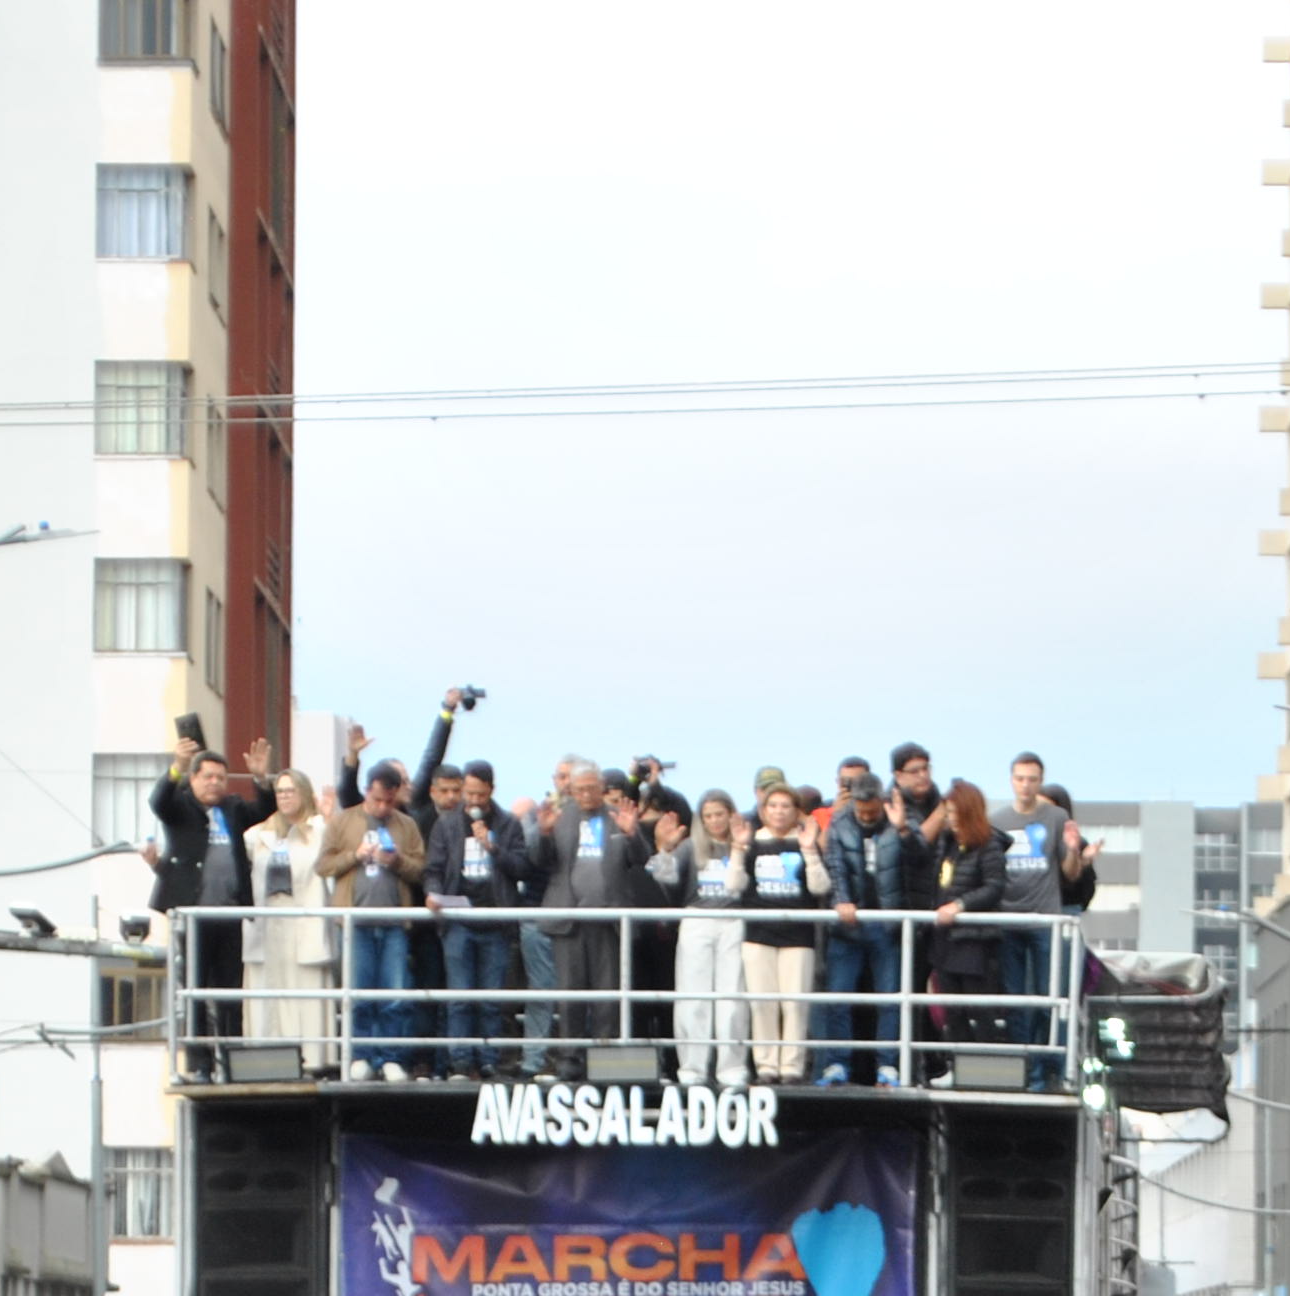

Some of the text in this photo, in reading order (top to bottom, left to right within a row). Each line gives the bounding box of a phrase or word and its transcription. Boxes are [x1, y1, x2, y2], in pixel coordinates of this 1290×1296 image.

[470, 1082, 779, 1149] AVASSALADOR
[411, 1231, 807, 1285] MARCHA
[617, 1277, 631, 1296] É
[633, 1281, 663, 1296] DO
[666, 1280, 745, 1296] SENHOR
[747, 1280, 806, 1296] JESUS
